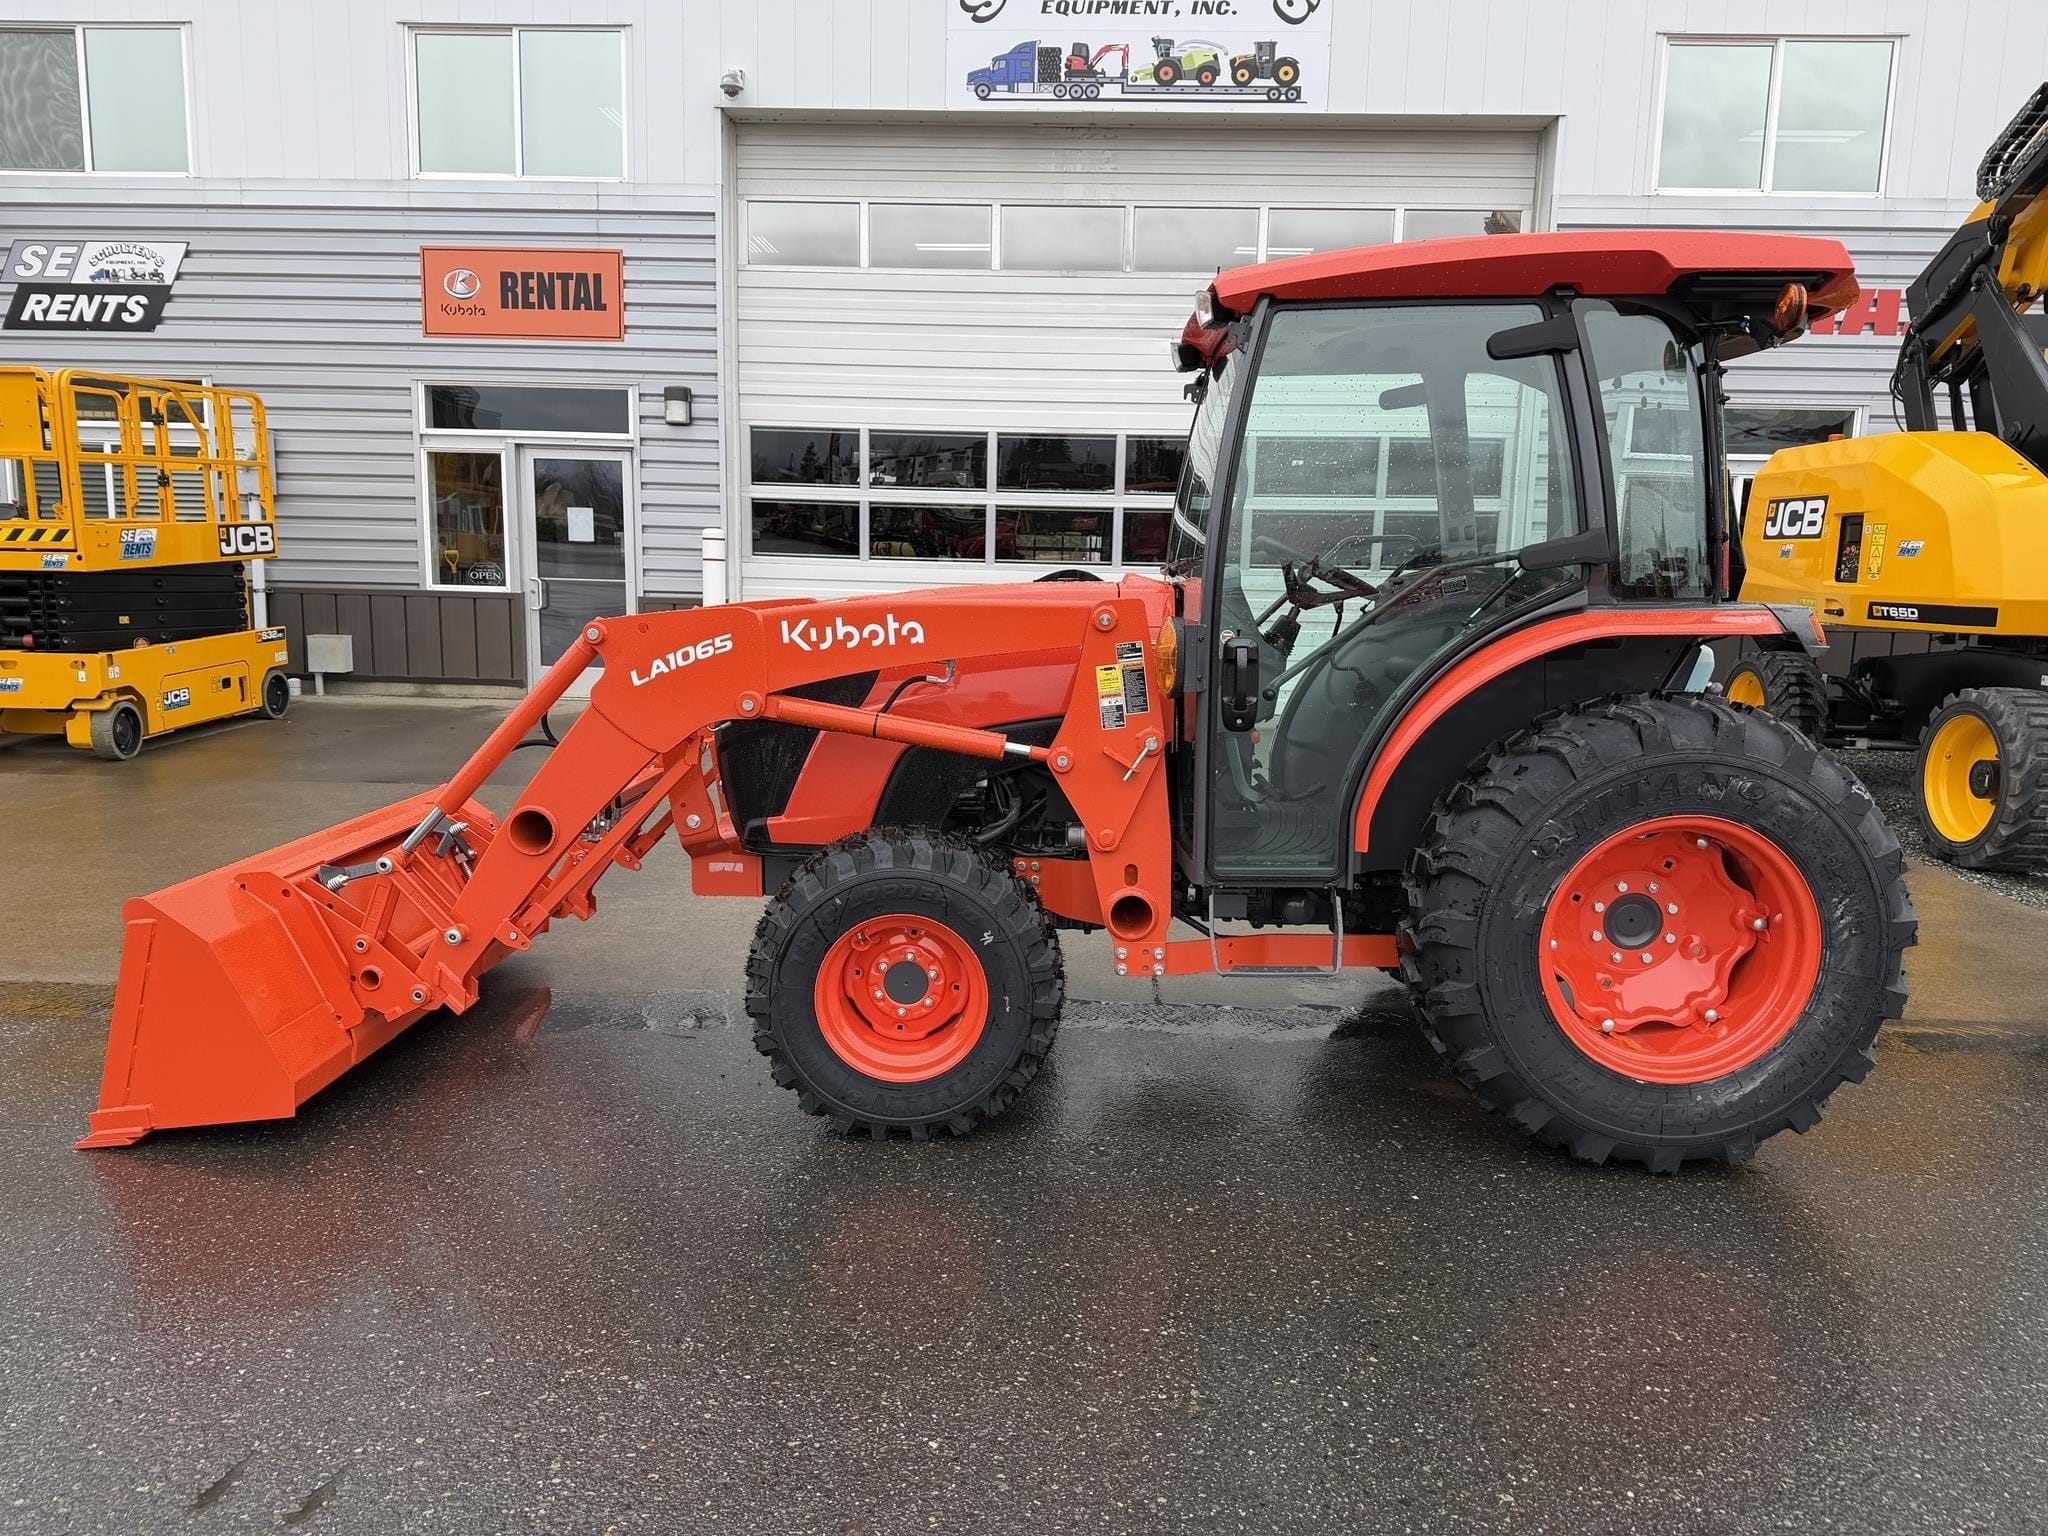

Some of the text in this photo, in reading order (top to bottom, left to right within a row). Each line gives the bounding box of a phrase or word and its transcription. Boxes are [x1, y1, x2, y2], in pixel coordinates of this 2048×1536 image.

[1041, 0, 1238, 17] EQUIPMENT, INC.
[14, 244, 78, 277] SE
[89, 243, 165, 267] SCHOLTEN'S
[500, 271, 607, 311] RENTAL
[20, 294, 149, 323] RENTS
[441, 303, 486, 316] Kubota
[1765, 499, 1826, 537] JCB
[120, 530, 135, 542] SE
[220, 526, 274, 554] JCB
[123, 543, 152, 555] RENTS
[470, 571, 501, 579] OPEN
[1881, 606, 1919, 618] T65D
[781, 613, 925, 650] Kubota
[629, 633, 734, 687] LA1065
[164, 688, 190, 704] JCB
